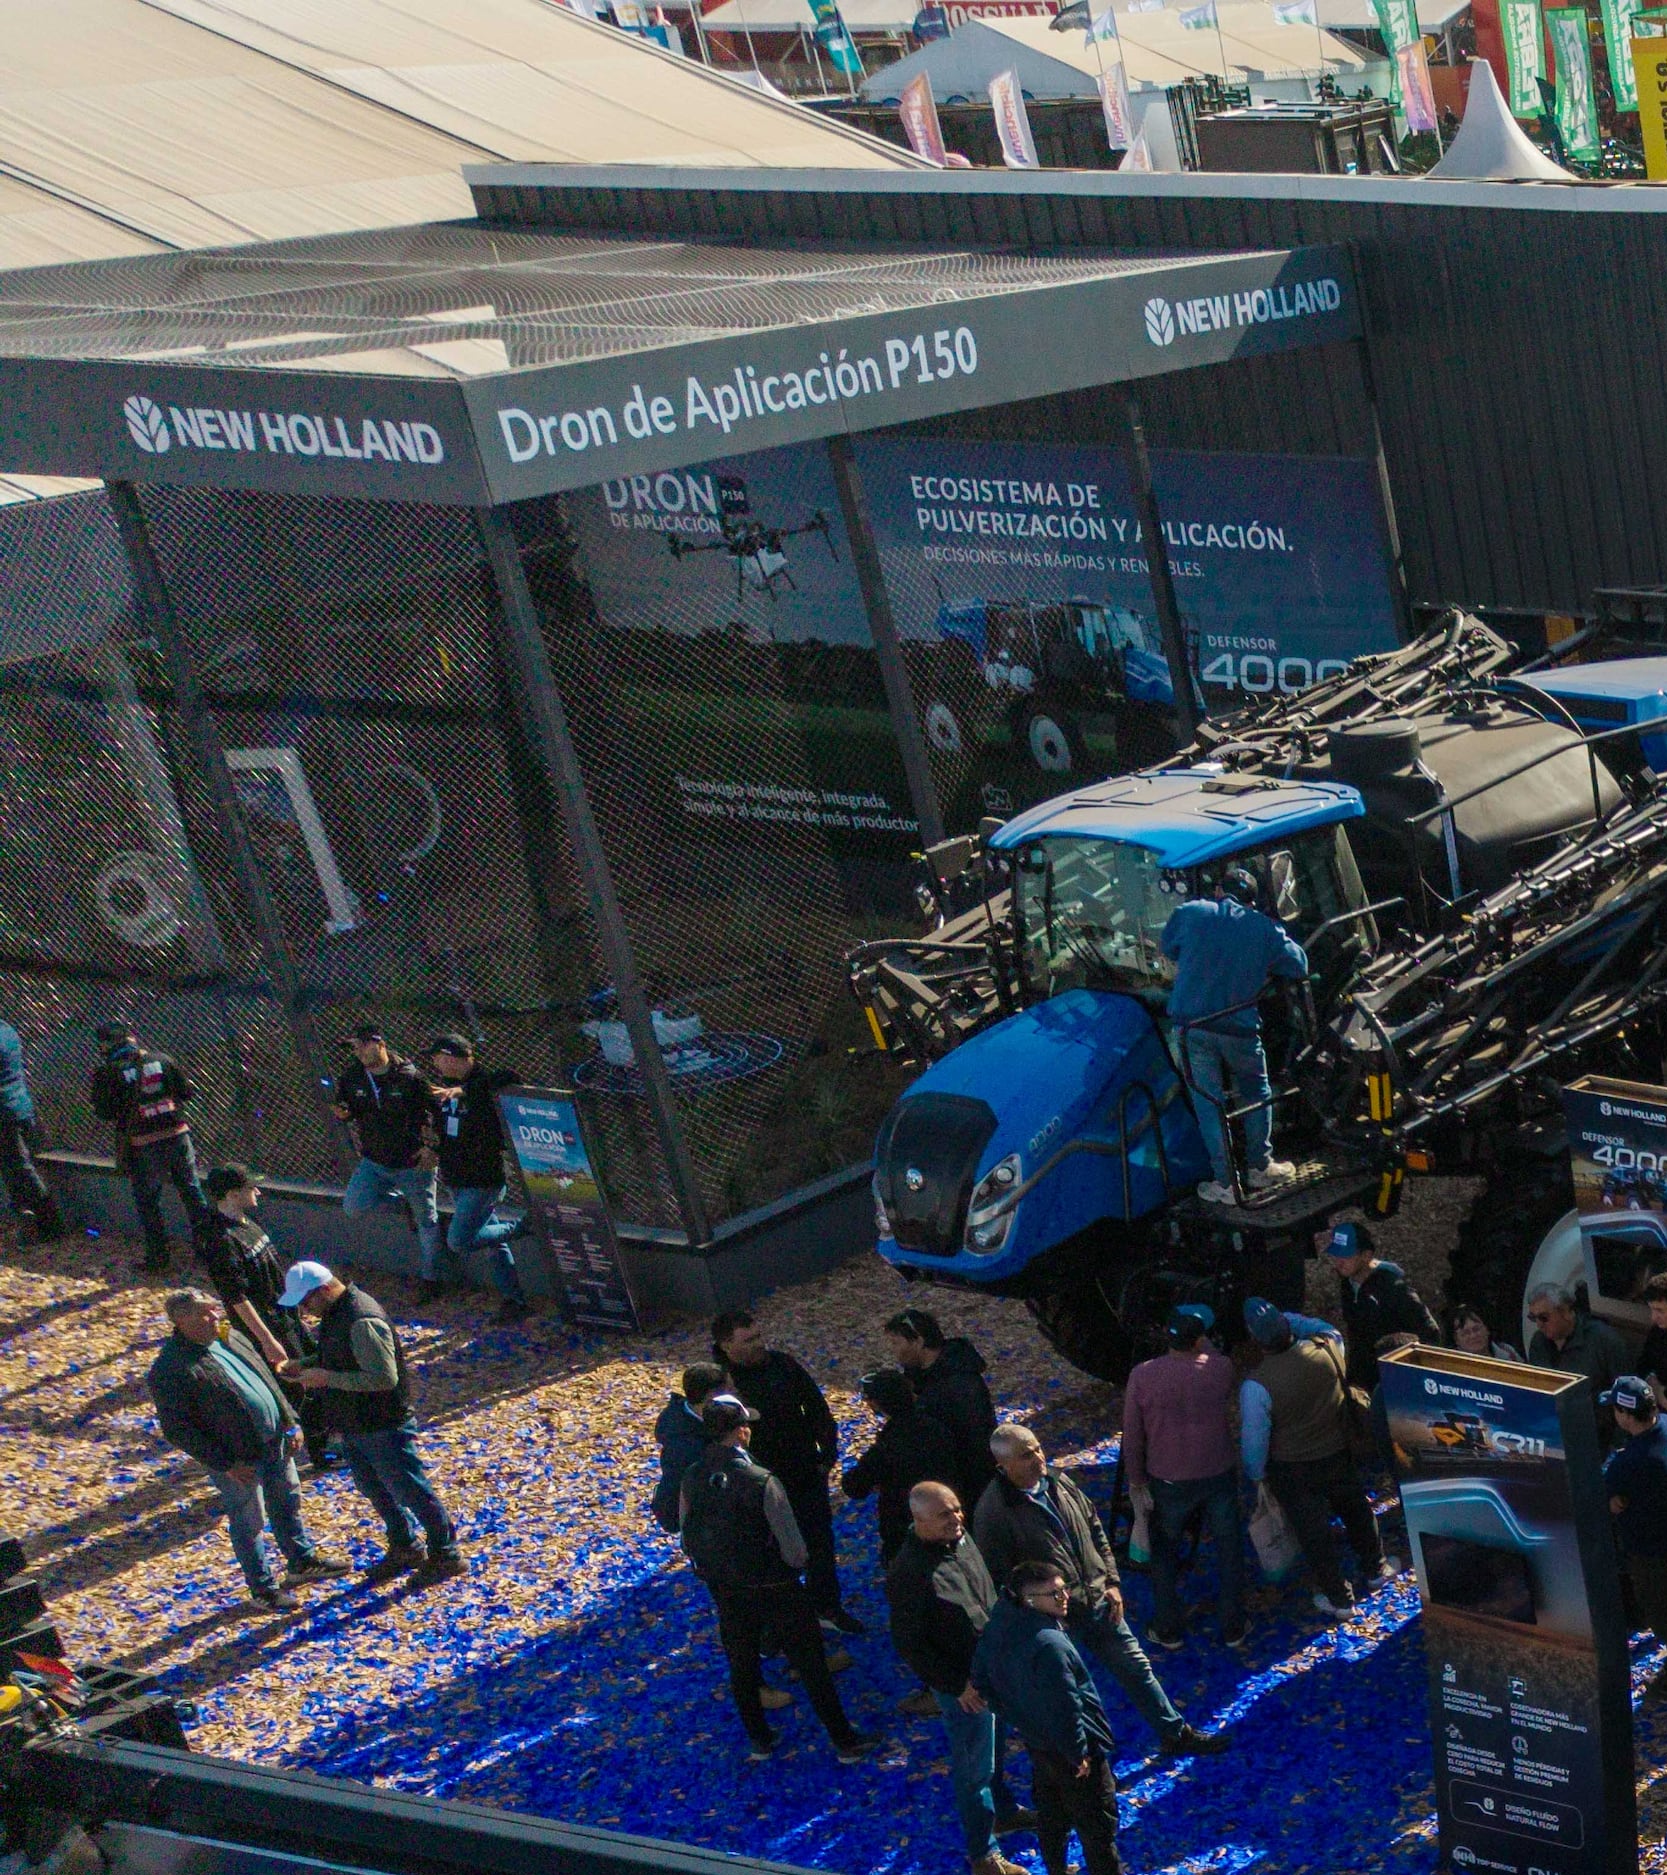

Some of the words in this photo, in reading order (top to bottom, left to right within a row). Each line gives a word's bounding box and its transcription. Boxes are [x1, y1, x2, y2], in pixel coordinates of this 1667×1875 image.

[1177, 296, 1243, 336] NEW
[1248, 279, 1341, 331] HOLLAND
[498, 404, 615, 462] Dron
[620, 386, 676, 434] de
[680, 346, 882, 428] Aplicación
[884, 327, 979, 388] P150
[172, 404, 258, 456] NEW
[263, 412, 444, 463] HOLLAND
[604, 476, 717, 514] DRON
[910, 475, 1061, 506] ECOSISTEMA
[1067, 483, 1101, 509] DE
[610, 512, 629, 528] DE
[631, 513, 722, 534] APLICACIÓN
[917, 508, 1107, 541] PULVERIZACIÓN
[1112, 518, 1130, 541] Y
[1134, 520, 1294, 551] ALICACIÓN.
[924, 545, 1001, 566] DECISIONES
[1043, 549, 1103, 570] RÁPIDAS
[1106, 555, 1118, 570] Y
[1120, 556, 1206, 578] RENBLES.
[1207, 633, 1278, 652] DEFENSOR
[1612, 1105, 1630, 1118] NEW
[1631, 1108, 1667, 1123] HOLLAND
[519, 1125, 565, 1146] DRON
[1581, 1131, 1625, 1147] DEFENSOR
[1439, 1383, 1460, 1398] NEW
[1461, 1387, 1504, 1405] HOLLAND
[1545, 1718, 1558, 1727] NEW
[1558, 1720, 1588, 1734] HOLLAND
[1504, 1803, 1531, 1817] DISEÑO
[1505, 1813, 1538, 1828] NATURAL
[1538, 1820, 1559, 1832] FLOW
